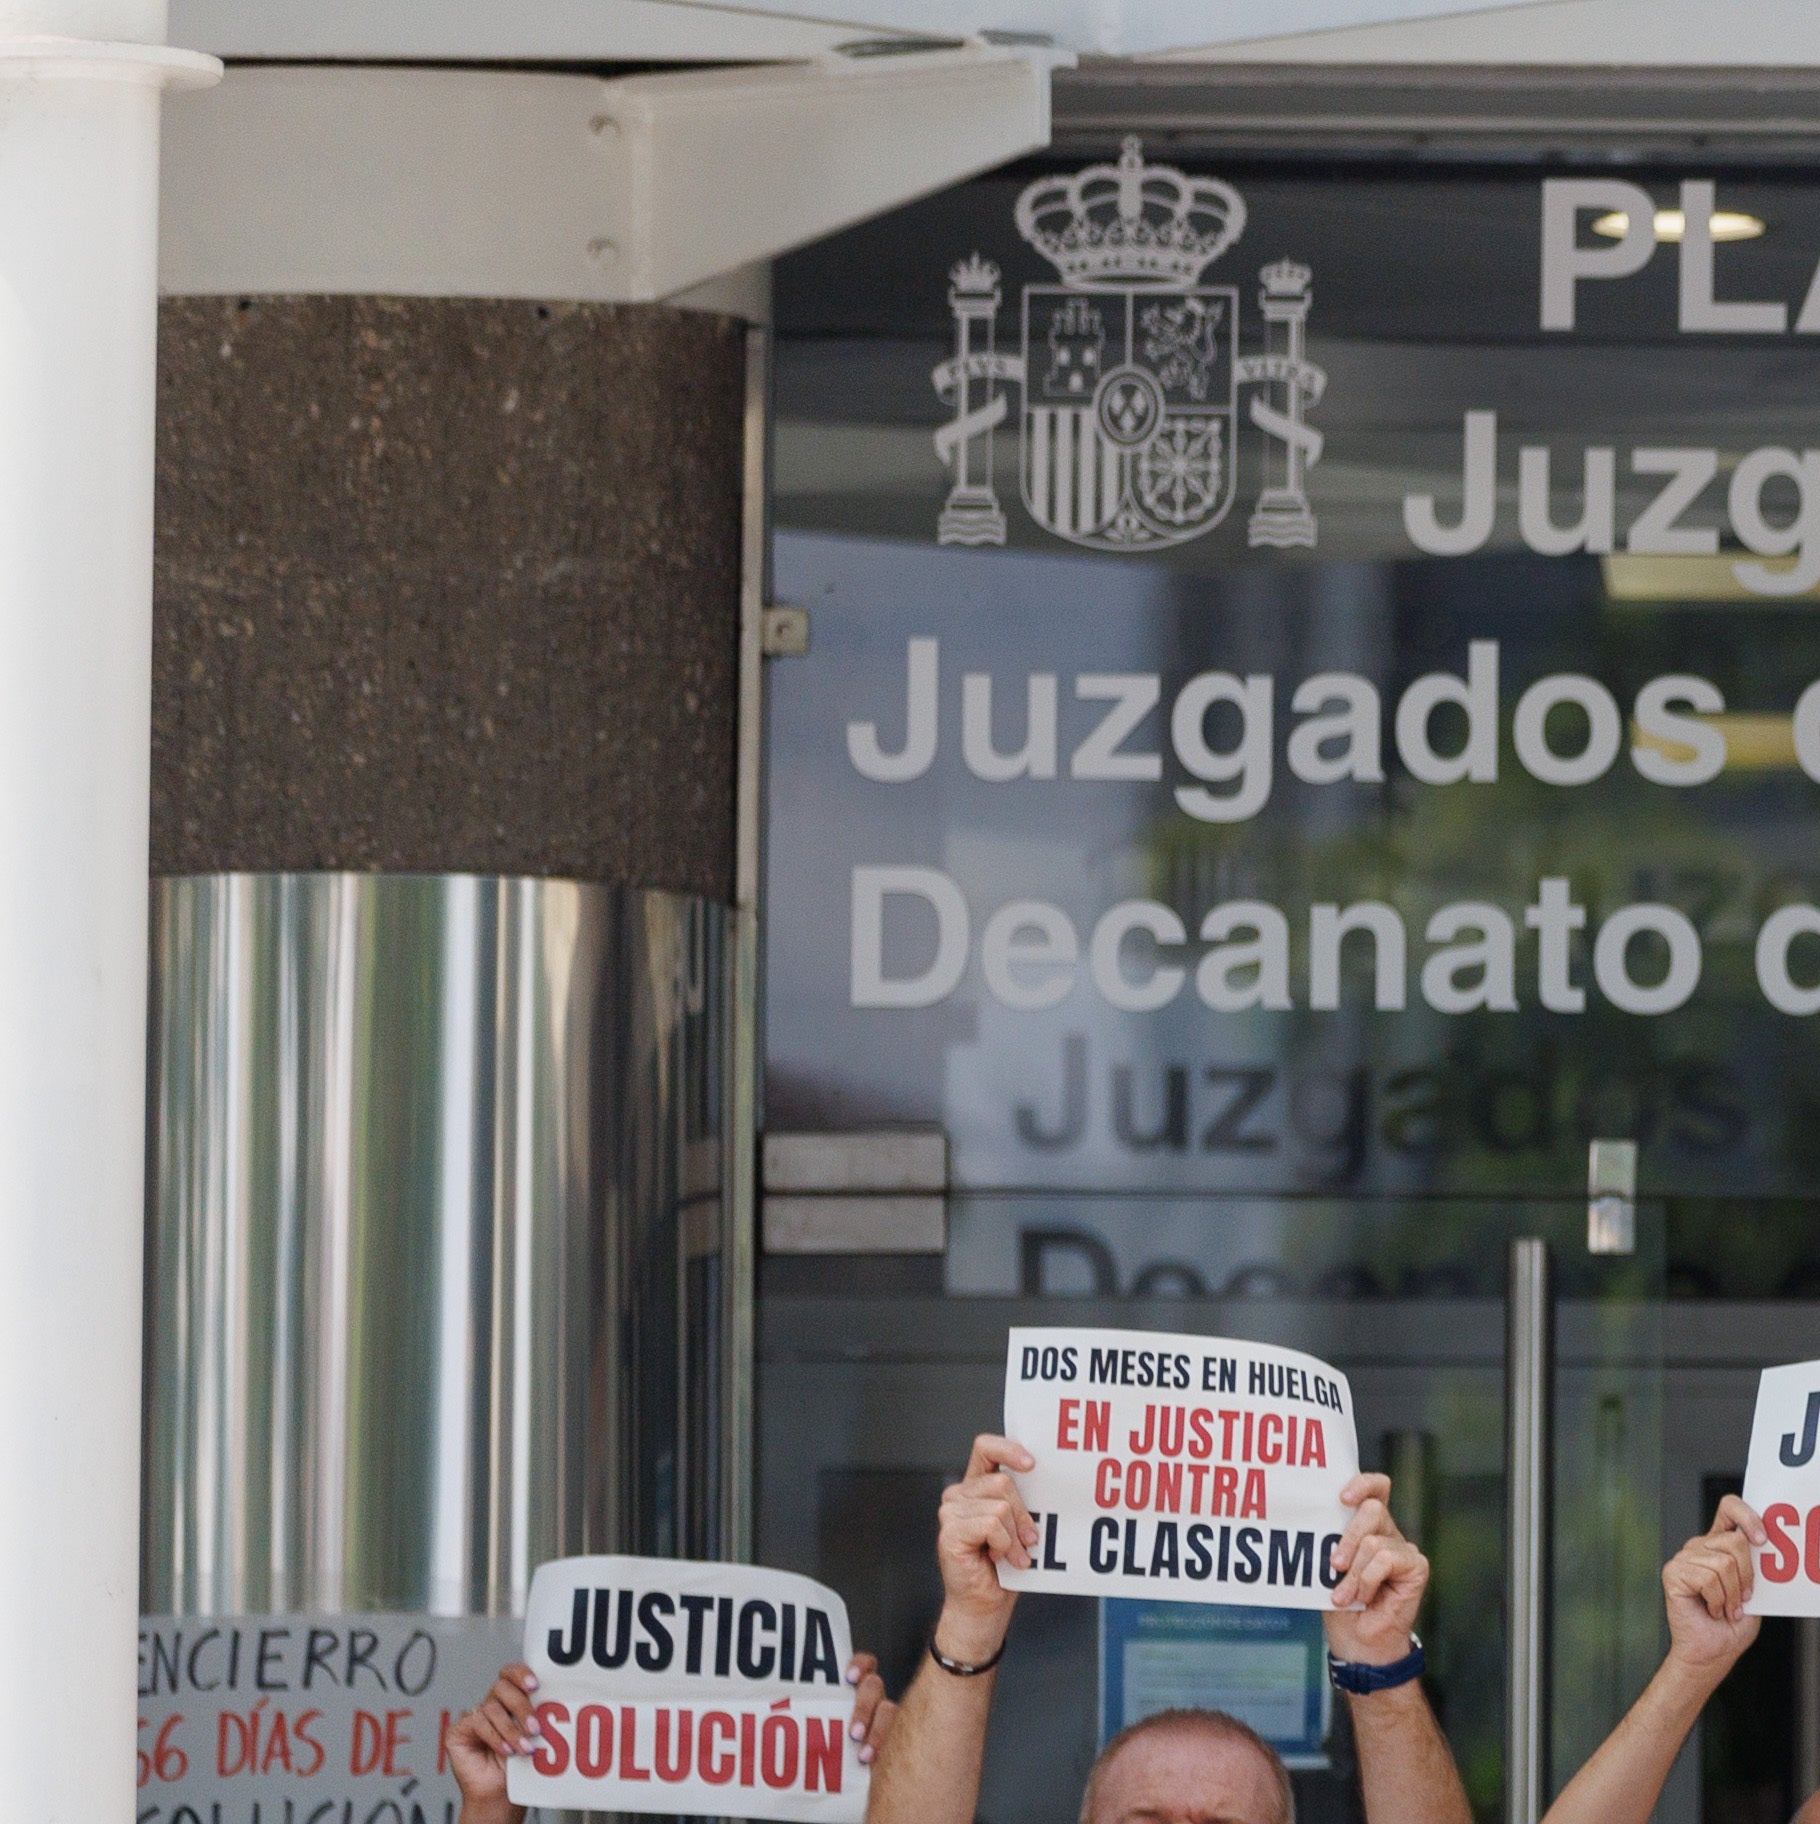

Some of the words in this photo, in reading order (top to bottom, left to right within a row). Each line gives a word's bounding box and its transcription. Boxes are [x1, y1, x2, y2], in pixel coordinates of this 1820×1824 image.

[847, 639, 1727, 823] Juzgados
[848, 866, 1702, 1017] Decanato
[1021, 1346, 1078, 1381] DOS
[1089, 1348, 1191, 1389] MESES
[1202, 1356, 1237, 1393] EN
[1249, 1361, 1344, 1415] HUELGA
[1057, 1398, 1111, 1452] EN
[1128, 1404, 1327, 1468] JUSTICIA
[1095, 1458, 1268, 1520] CONTRA
[548, 1588, 840, 1686] JUSTICIA
[216, 1694, 326, 1778] DÍAS
[349, 1708, 413, 1776] DE
[532, 1696, 844, 1794] SOLUCIÓN
